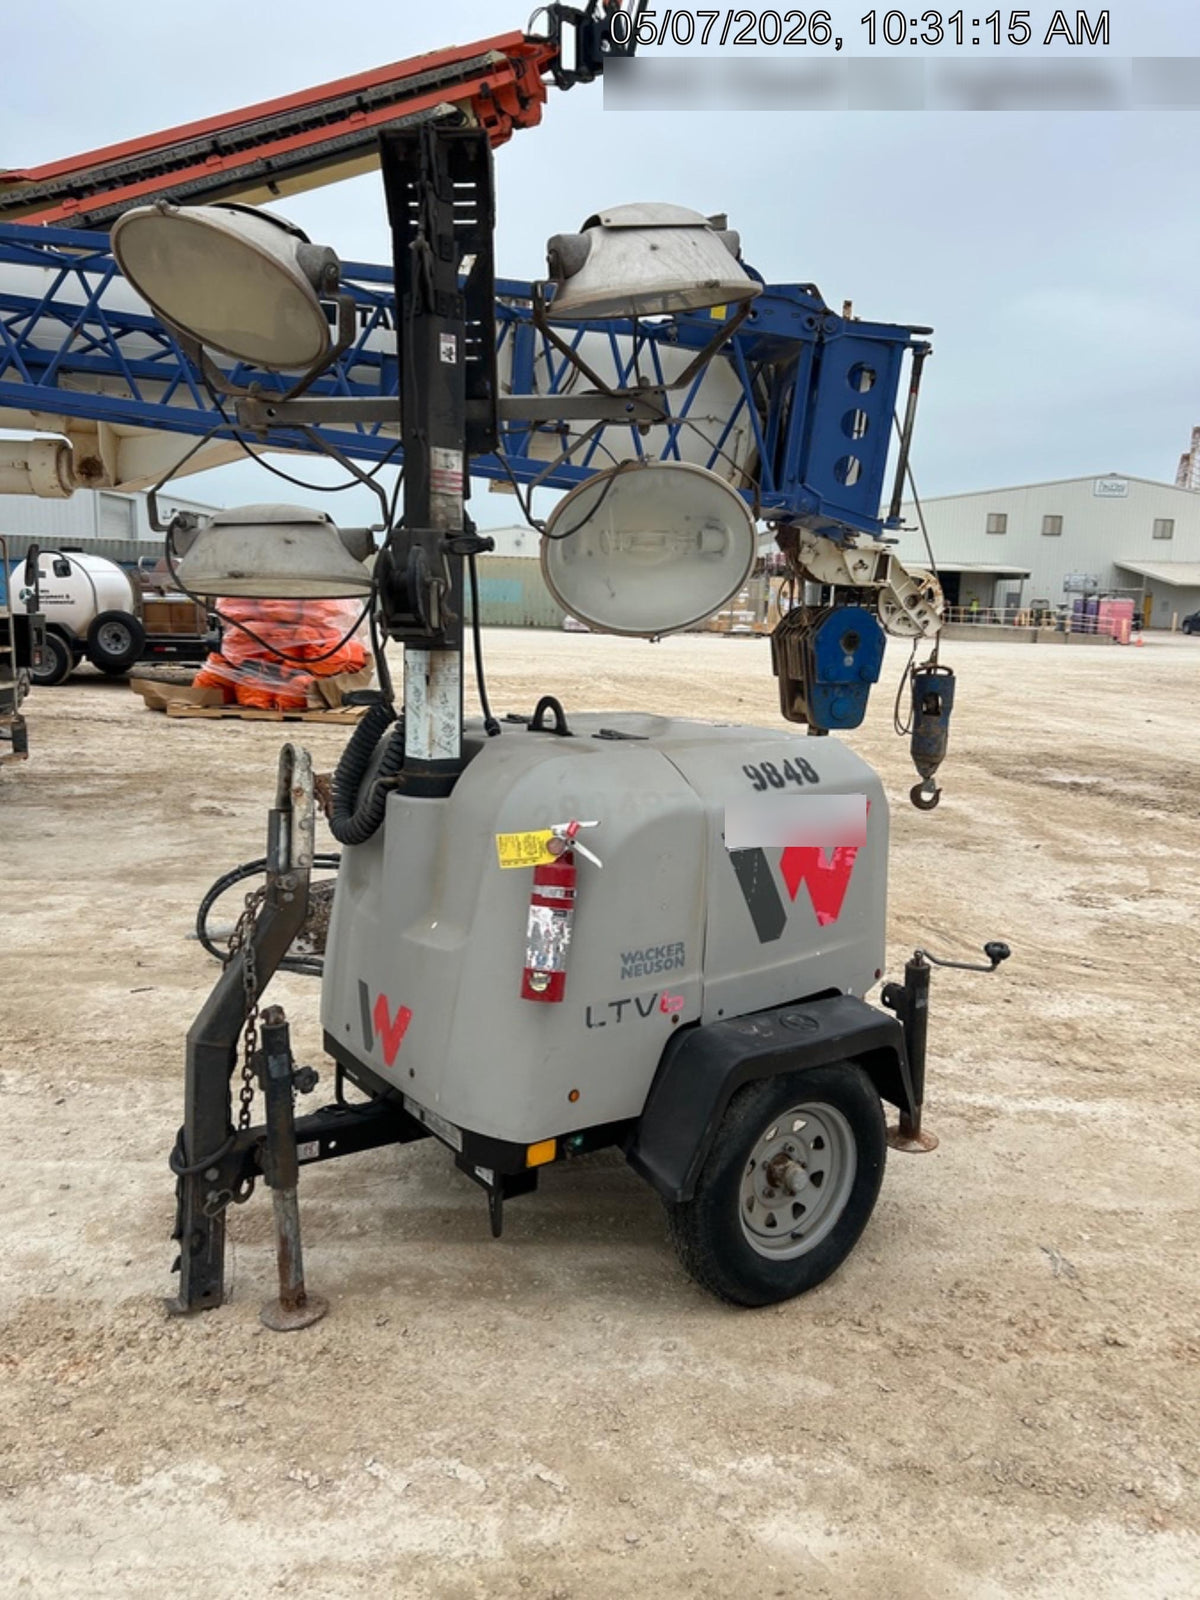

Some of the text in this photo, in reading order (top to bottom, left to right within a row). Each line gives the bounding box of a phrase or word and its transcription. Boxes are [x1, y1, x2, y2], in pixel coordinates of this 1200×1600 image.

[742, 757, 820, 792] 9848
[620, 941, 685, 965] WACKER
[620, 955, 685, 980] NEUSON
